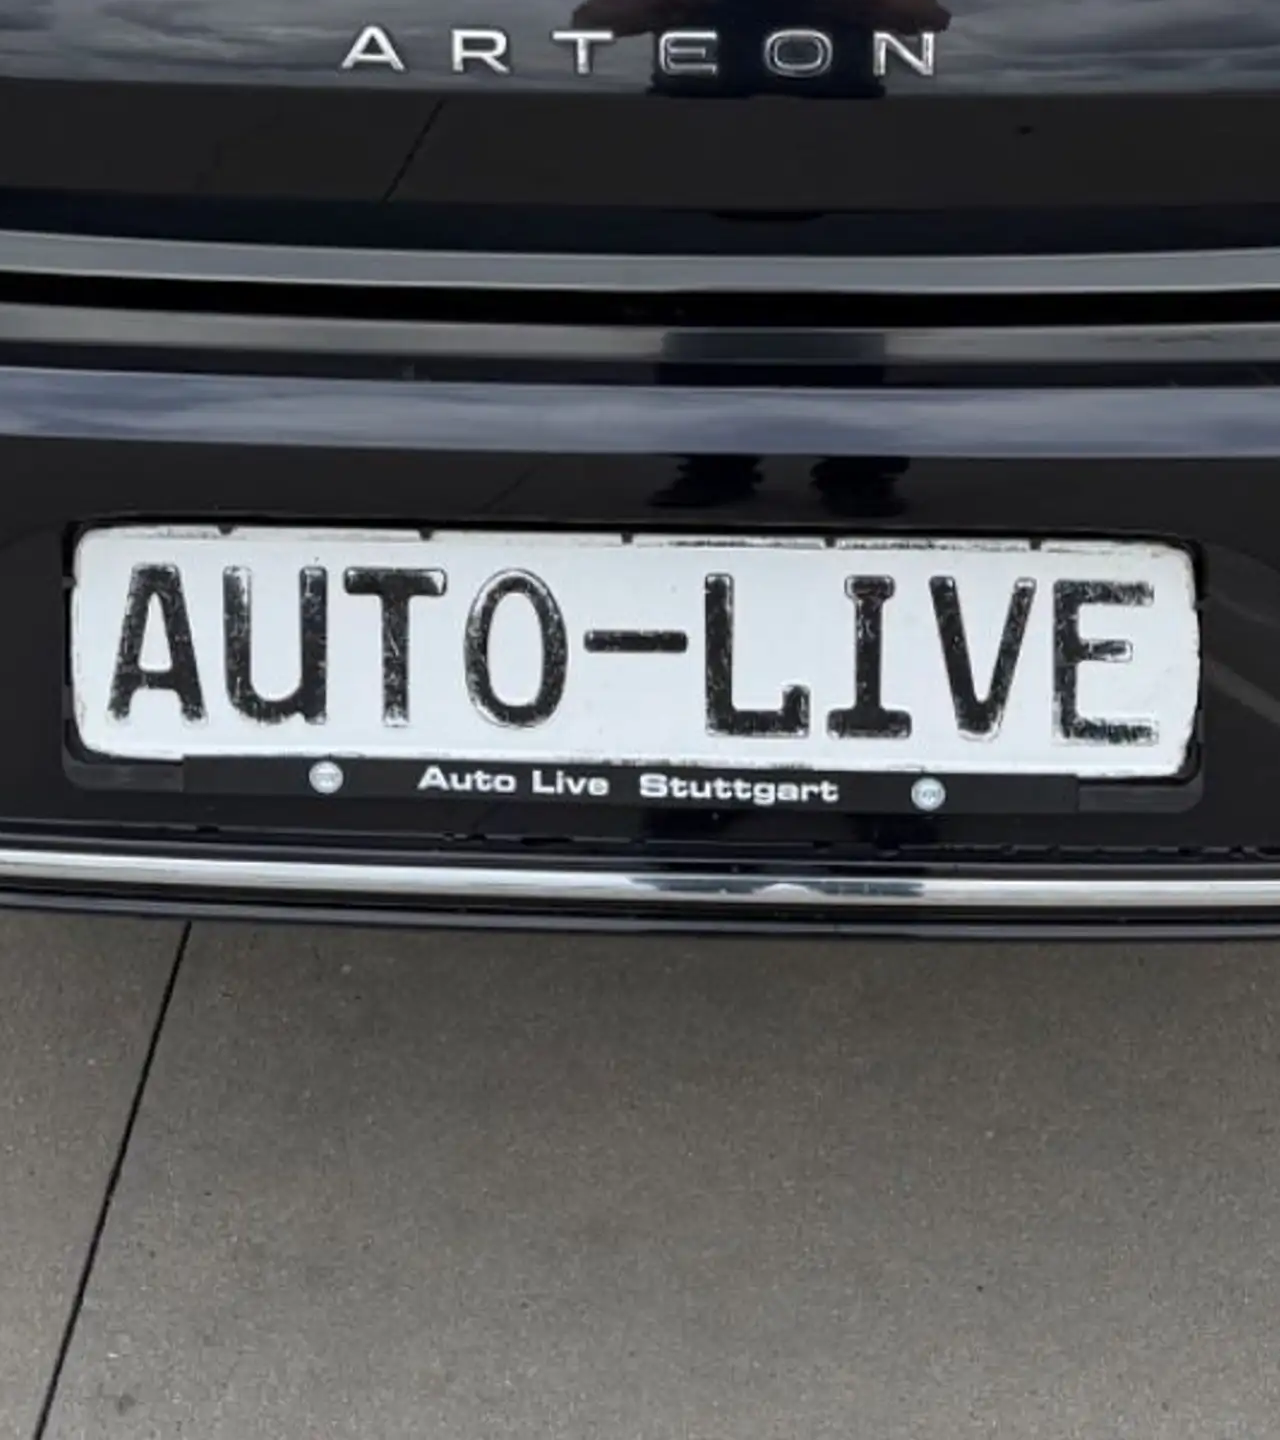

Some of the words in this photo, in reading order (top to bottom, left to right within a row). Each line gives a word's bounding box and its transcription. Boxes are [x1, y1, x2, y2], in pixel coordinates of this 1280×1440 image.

[341, 26, 935, 76] ARTEON
[106, 562, 1160, 747] AUTO-LIVE
[419, 765, 517, 794] Auto
[531, 769, 611, 797] Live
[638, 772, 840, 806] Stuttgart
